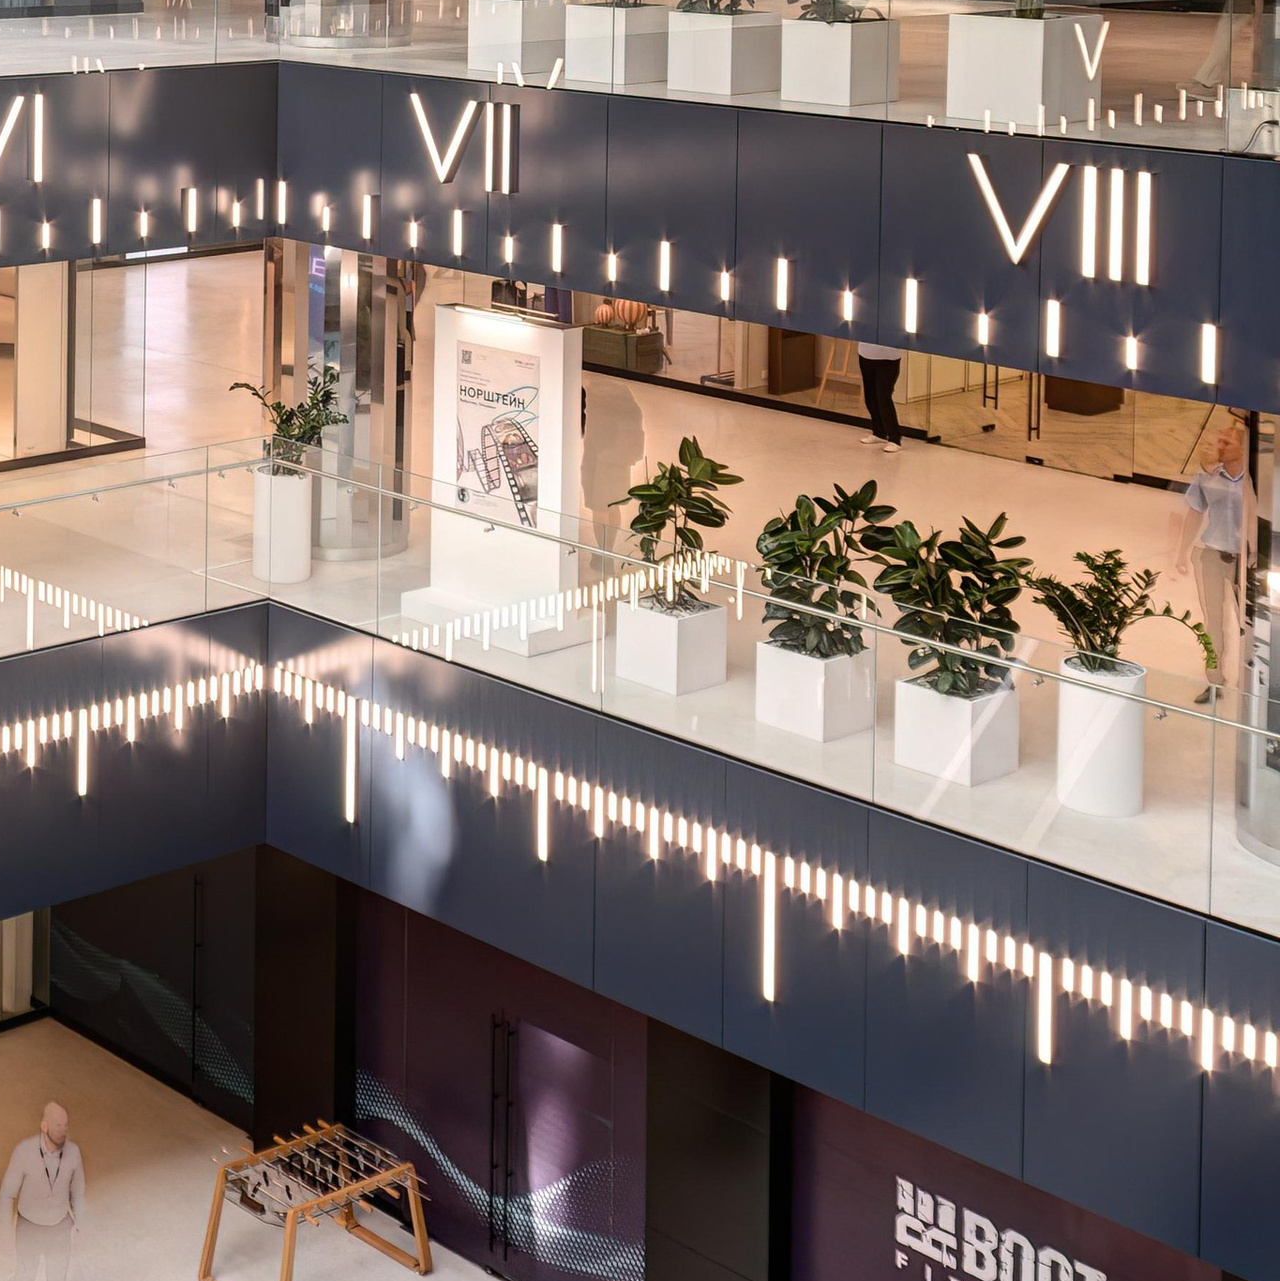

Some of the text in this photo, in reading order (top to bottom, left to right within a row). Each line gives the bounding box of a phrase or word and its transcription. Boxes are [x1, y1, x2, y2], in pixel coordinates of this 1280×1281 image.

[409, 93, 512, 195] VII
[967, 153, 1152, 286] VIII
[459, 384, 526, 410] НОРШТЕЙН
